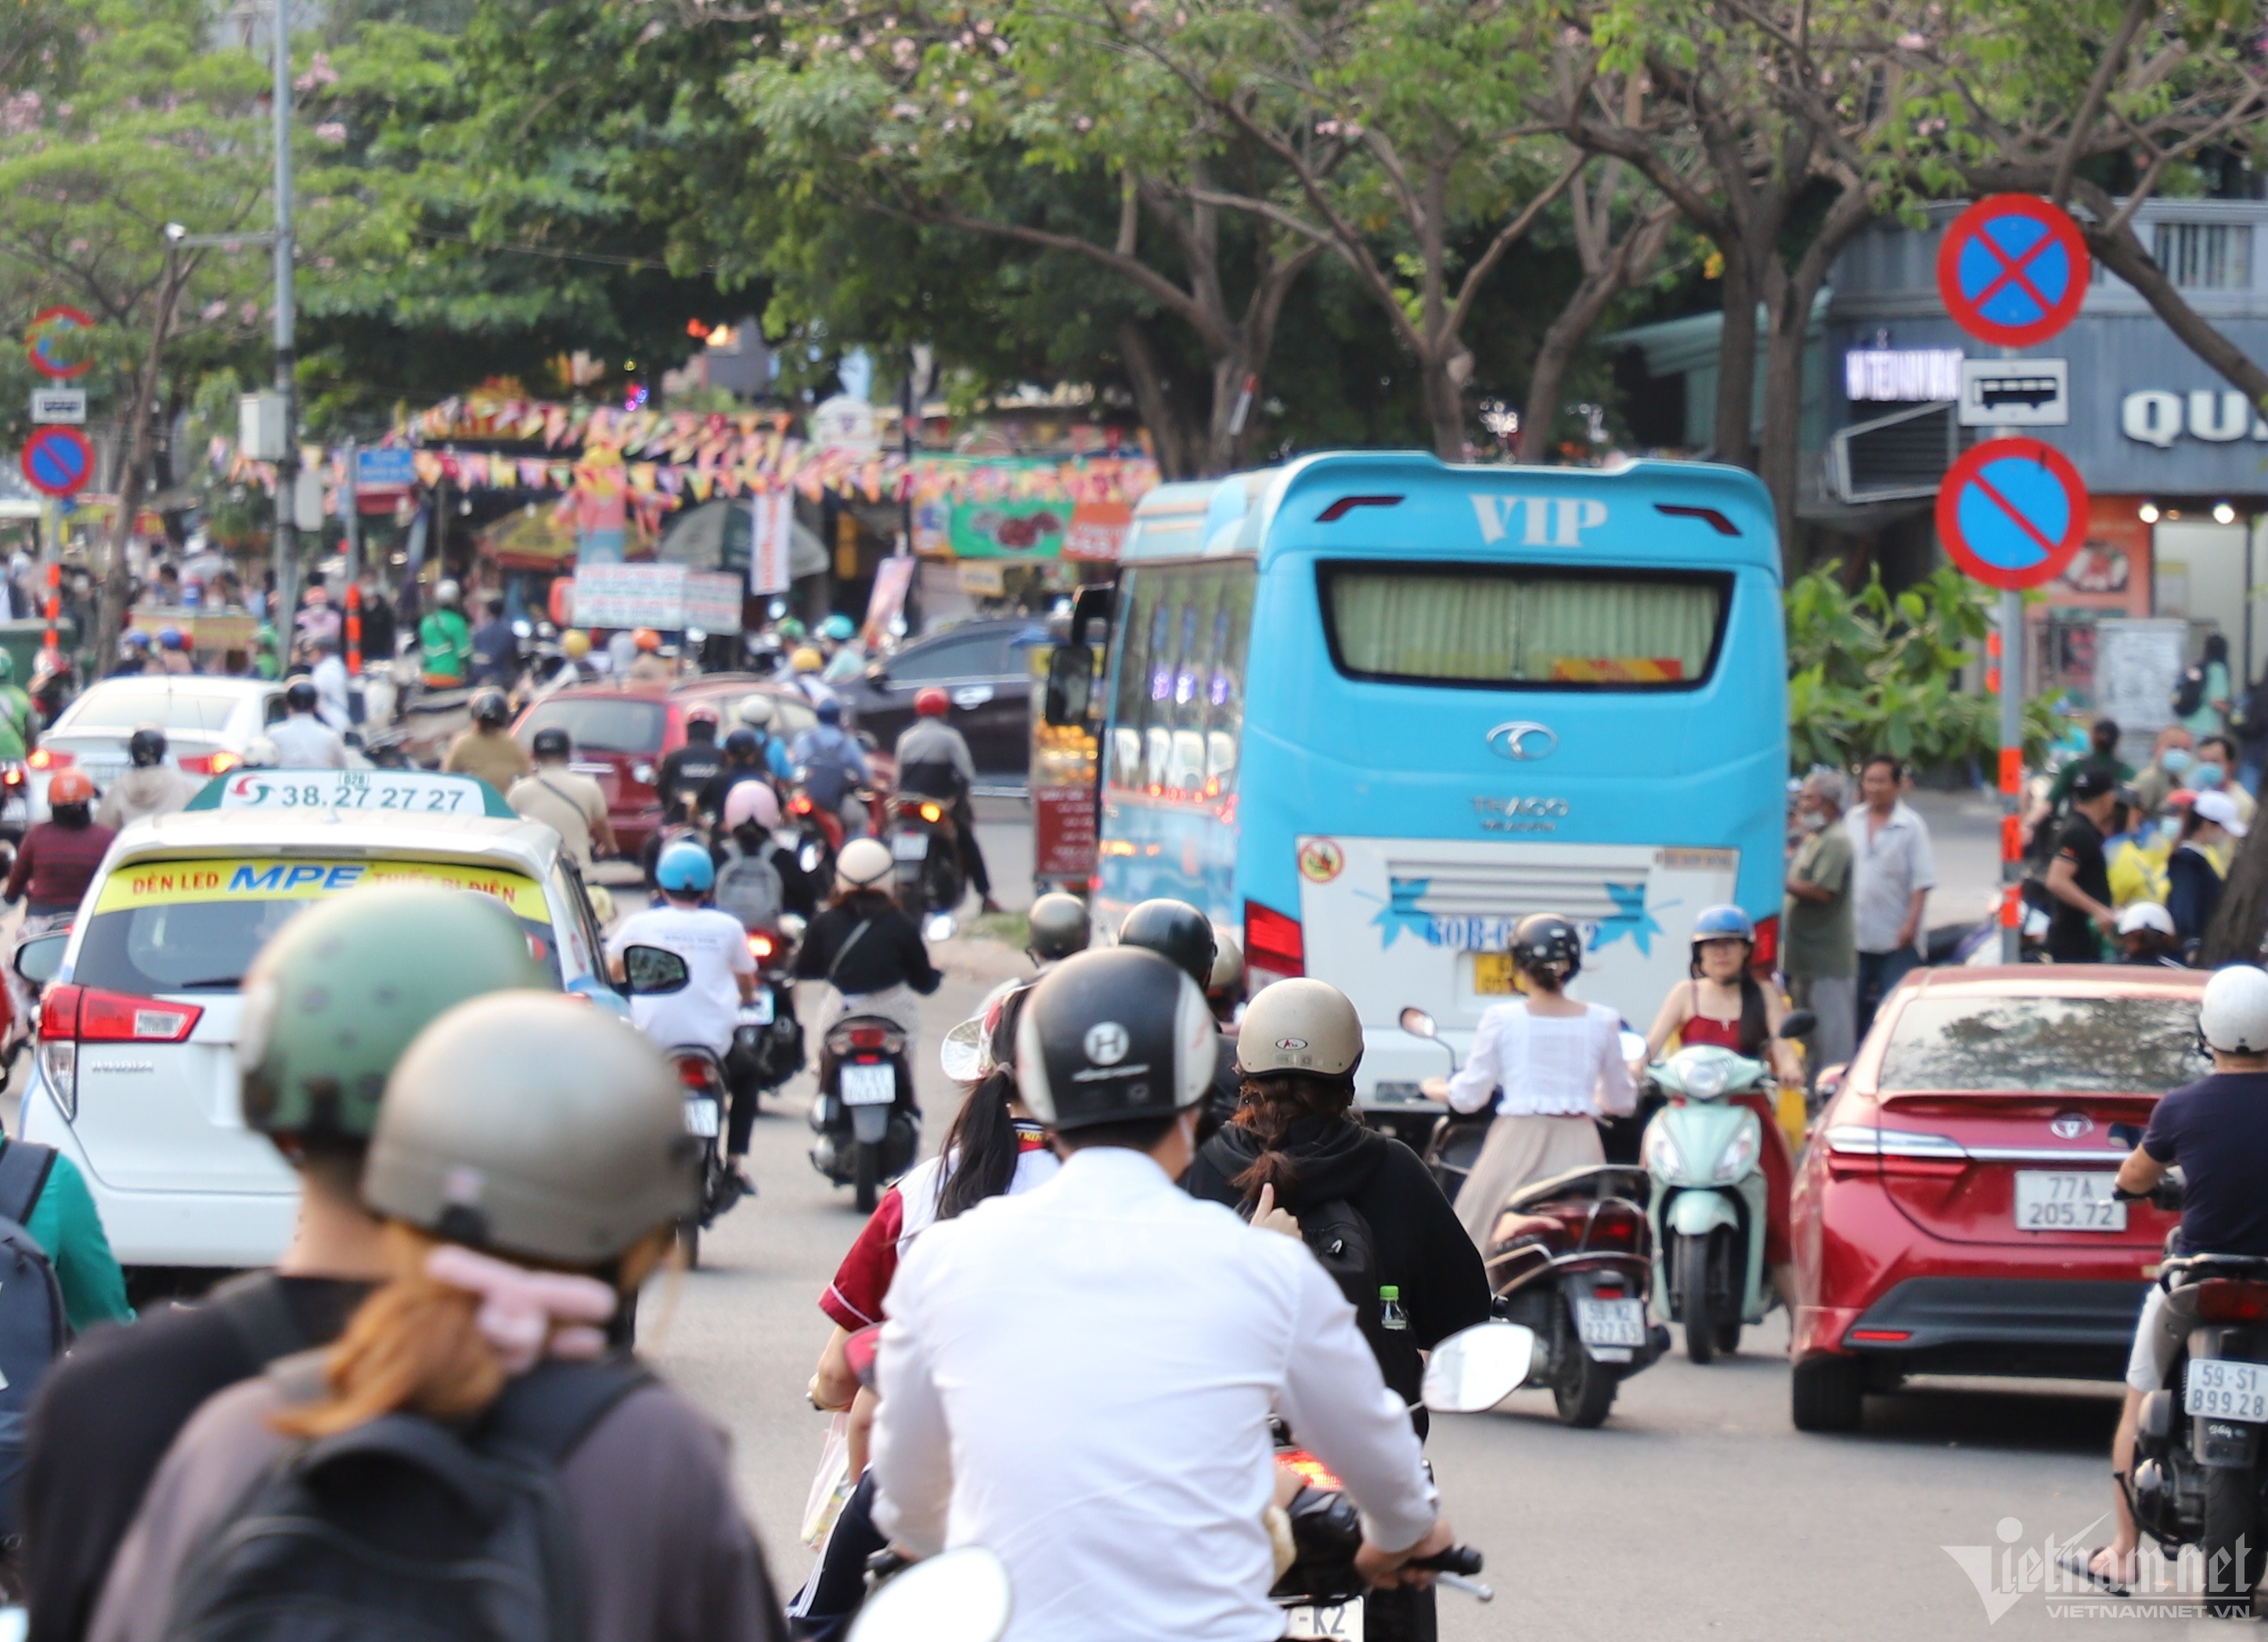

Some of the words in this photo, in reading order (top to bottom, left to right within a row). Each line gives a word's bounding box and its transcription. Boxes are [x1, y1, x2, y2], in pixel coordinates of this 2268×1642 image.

[1467, 493, 1610, 547] VIP
[181, 871, 219, 892] LED
[227, 863, 366, 893] MPE
[2049, 1176, 2093, 1199] 77A
[2029, 1202, 2113, 1225] 205.72
